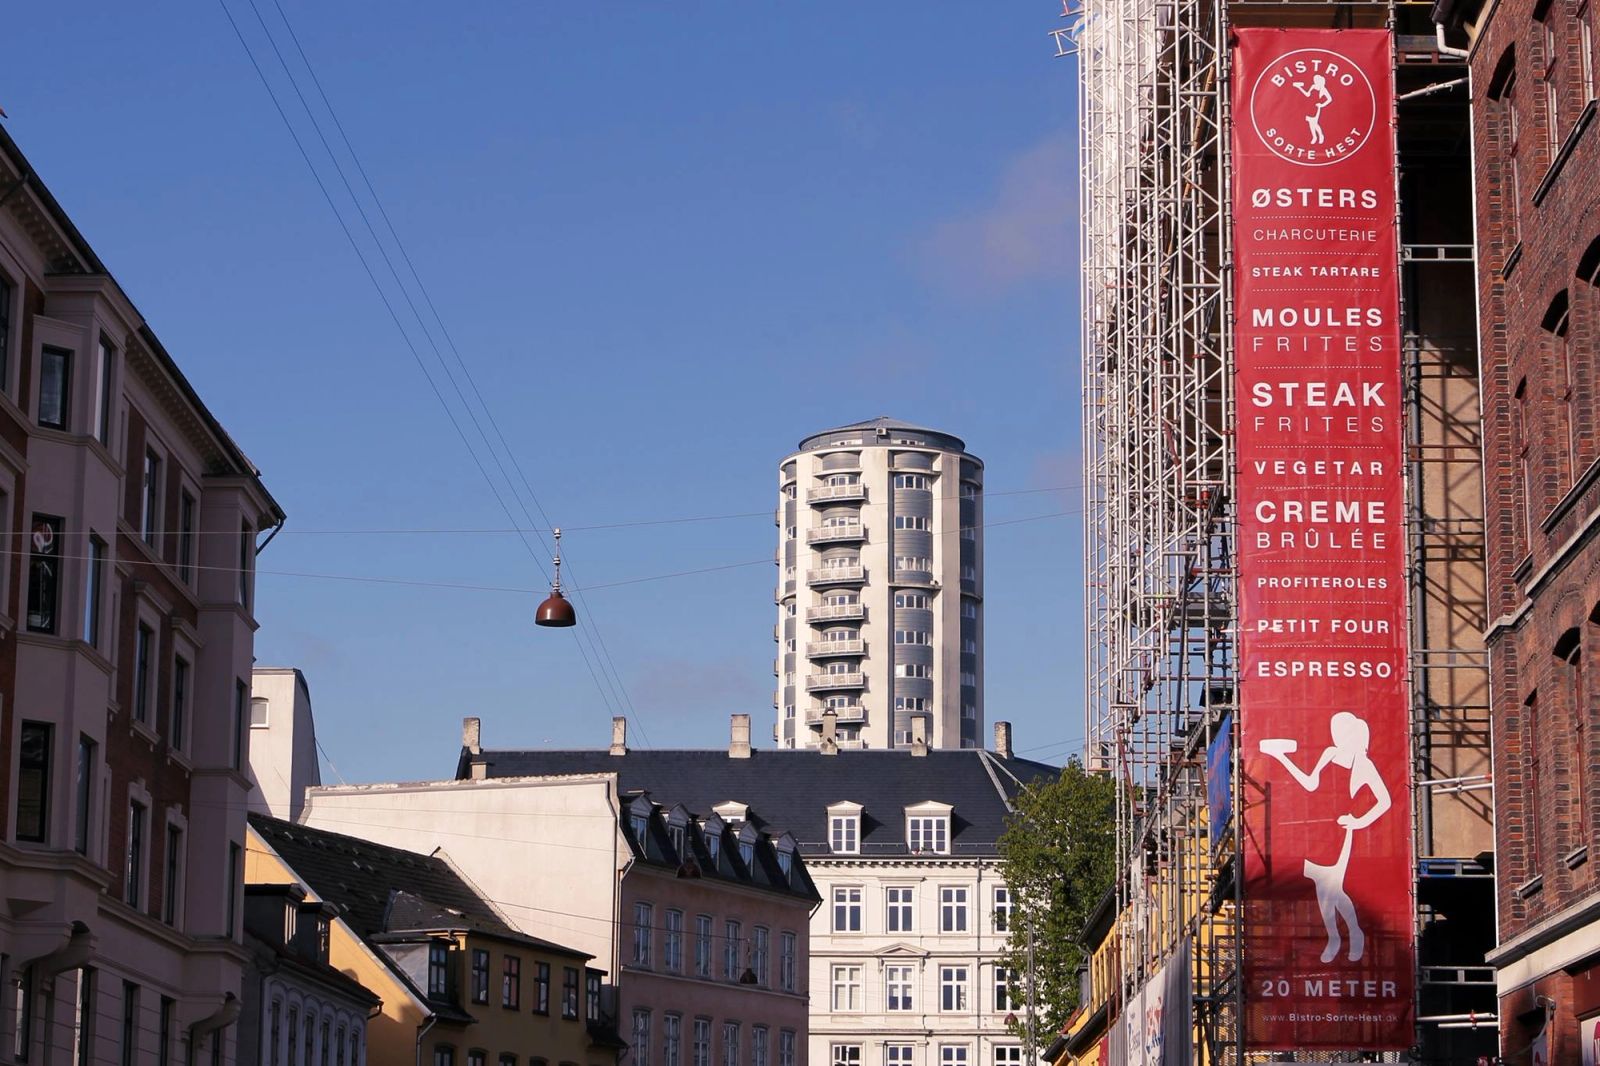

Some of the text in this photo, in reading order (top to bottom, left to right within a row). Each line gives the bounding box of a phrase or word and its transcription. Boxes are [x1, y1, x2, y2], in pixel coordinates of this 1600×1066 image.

[1271, 59, 1353, 87] BISTRO
[1266, 128, 1362, 159] SORTE HEST
[1252, 188, 1377, 209] ØSTERS
[1253, 228, 1377, 242] CHARCUTERIE
[1252, 267, 1380, 277] STEAK TARTARE
[1252, 308, 1382, 327] MOULES
[1253, 336, 1382, 352] FRITES
[1252, 382, 1385, 407] STEAK
[1254, 416, 1384, 432] FRITES
[1254, 461, 1383, 475] VEGETAR
[1255, 501, 1385, 524] CREME
[1257, 528, 1386, 549] BRÛLÉE
[1257, 577, 1388, 588] PROFITEROLES
[1257, 619, 1389, 633] PETIT FOUR
[1258, 661, 1391, 678] ESPRESSO
[1261, 980, 1396, 997] 20 METER
[1261, 1013, 1399, 1022] www.Bistro-Sorte-Hest.dk
